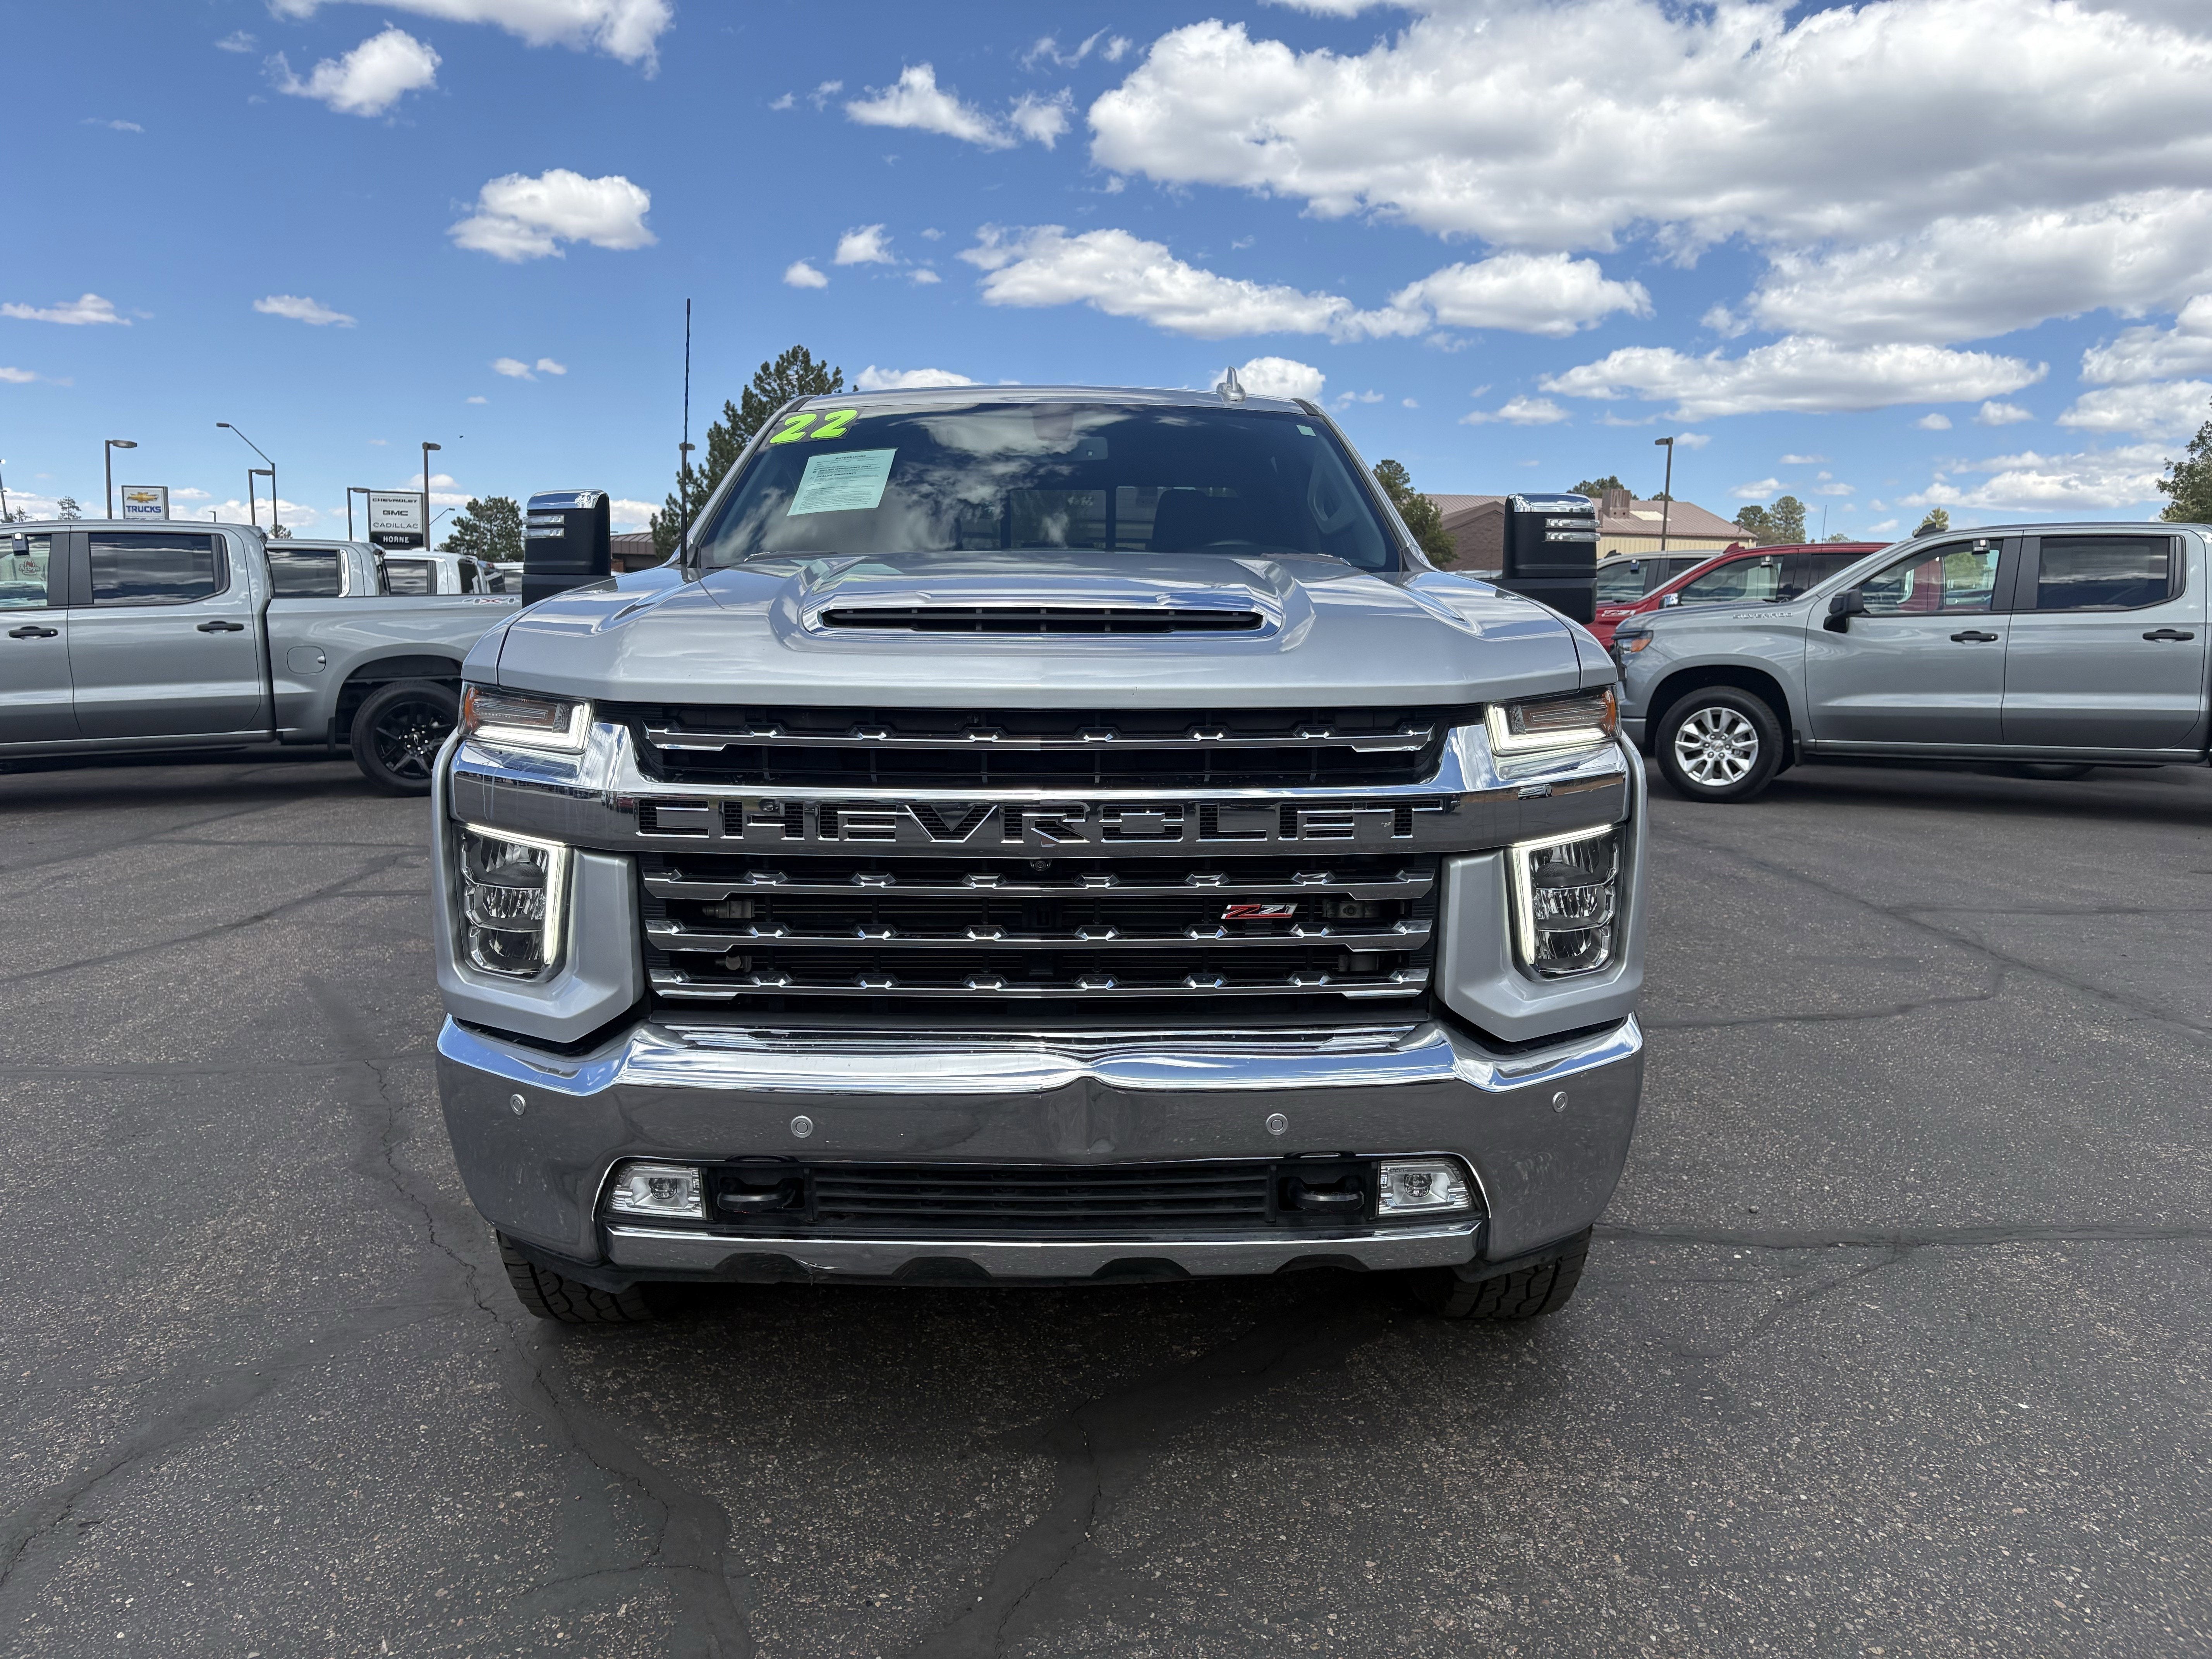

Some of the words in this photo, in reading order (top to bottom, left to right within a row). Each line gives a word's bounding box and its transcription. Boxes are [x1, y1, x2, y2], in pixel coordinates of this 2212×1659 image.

[770, 409, 857, 444] 22
[635, 799, 1442, 843] CHEVROLET
[1221, 904, 1298, 919] Z71
